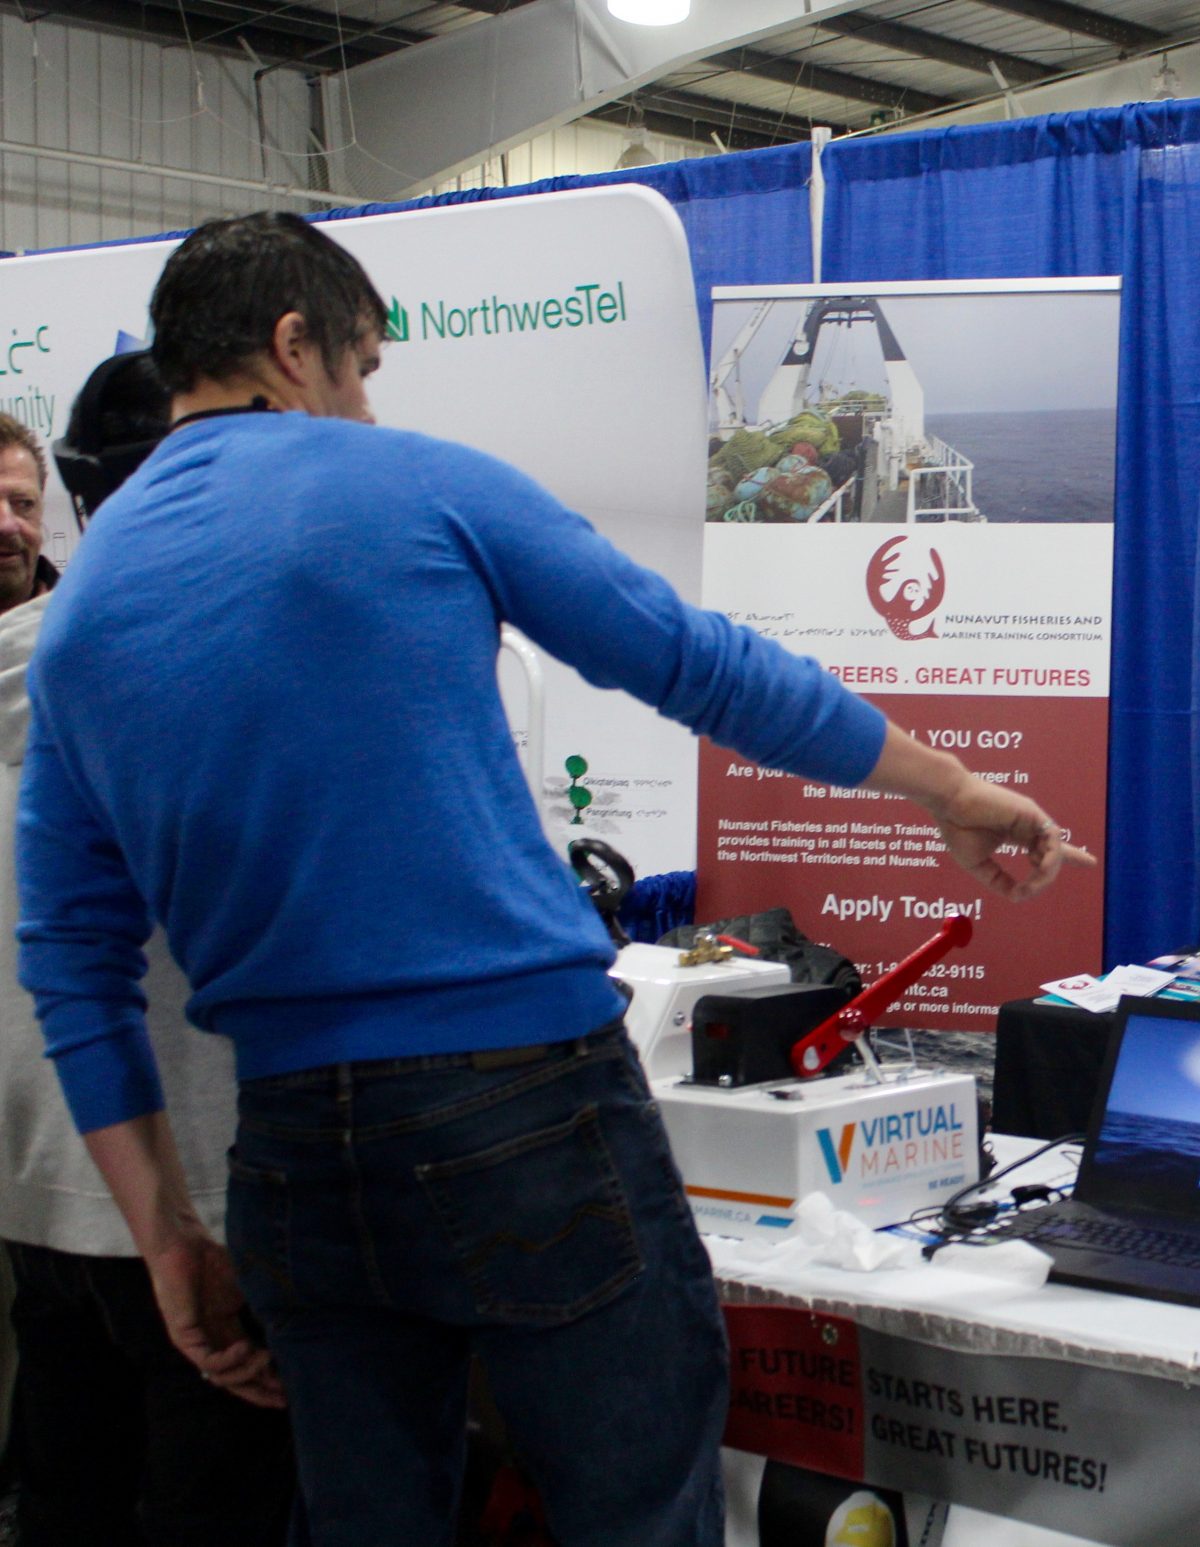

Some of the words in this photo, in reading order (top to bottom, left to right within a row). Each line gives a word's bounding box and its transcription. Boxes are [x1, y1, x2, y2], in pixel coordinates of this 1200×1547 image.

[420, 280, 627, 341] NorthwesTel
[945, 614, 1010, 625] NUNAVUT
[1012, 615, 1071, 625] FISHERIES
[1074, 616, 1103, 626] AND
[942, 631, 982, 640] MARINE
[984, 631, 1034, 641] TRAINING
[1036, 632, 1103, 642] CONSORTIUM
[826, 666, 898, 684] REERS
[915, 667, 987, 685] GREAT
[993, 668, 1091, 687] FUTURES
[927, 729, 972, 748] YOU
[976, 730, 1024, 749] GO?
[726, 763, 753, 777] Are
[1014, 769, 1029, 784] in
[803, 784, 826, 798] the
[718, 819, 769, 831] Nunavut
[771, 820, 823, 833] Fisheries
[825, 822, 848, 834] and
[850, 823, 892, 835] Marine
[894, 824, 942, 839] Training
[717, 835, 770, 848] provides
[772, 836, 816, 850] training
[818, 837, 830, 849] in
[832, 838, 847, 849] all
[849, 838, 888, 850] facets
[889, 839, 902, 851] of
[903, 840, 923, 852] the
[925, 841, 951, 853] Mar
[717, 849, 738, 861] the
[740, 851, 798, 864] Northwest
[801, 852, 861, 866] Territories
[863, 854, 886, 867] and
[888, 855, 940, 868] Nunavik.
[821, 893, 894, 923] Apply
[900, 895, 982, 921] Today!
[903, 1001, 917, 1011] or
[919, 1002, 949, 1013] more
[860, 1103, 963, 1147] VIRTUAL
[860, 1133, 965, 1178] MARINE
[738, 1347, 855, 1387] FUTURE
[867, 1366, 965, 1418] STARTS
[971, 1394, 1068, 1434] HERE.
[730, 1388, 855, 1434] AREERS!
[870, 1413, 957, 1459] GREAT
[964, 1438, 1108, 1494] FUTURES!
